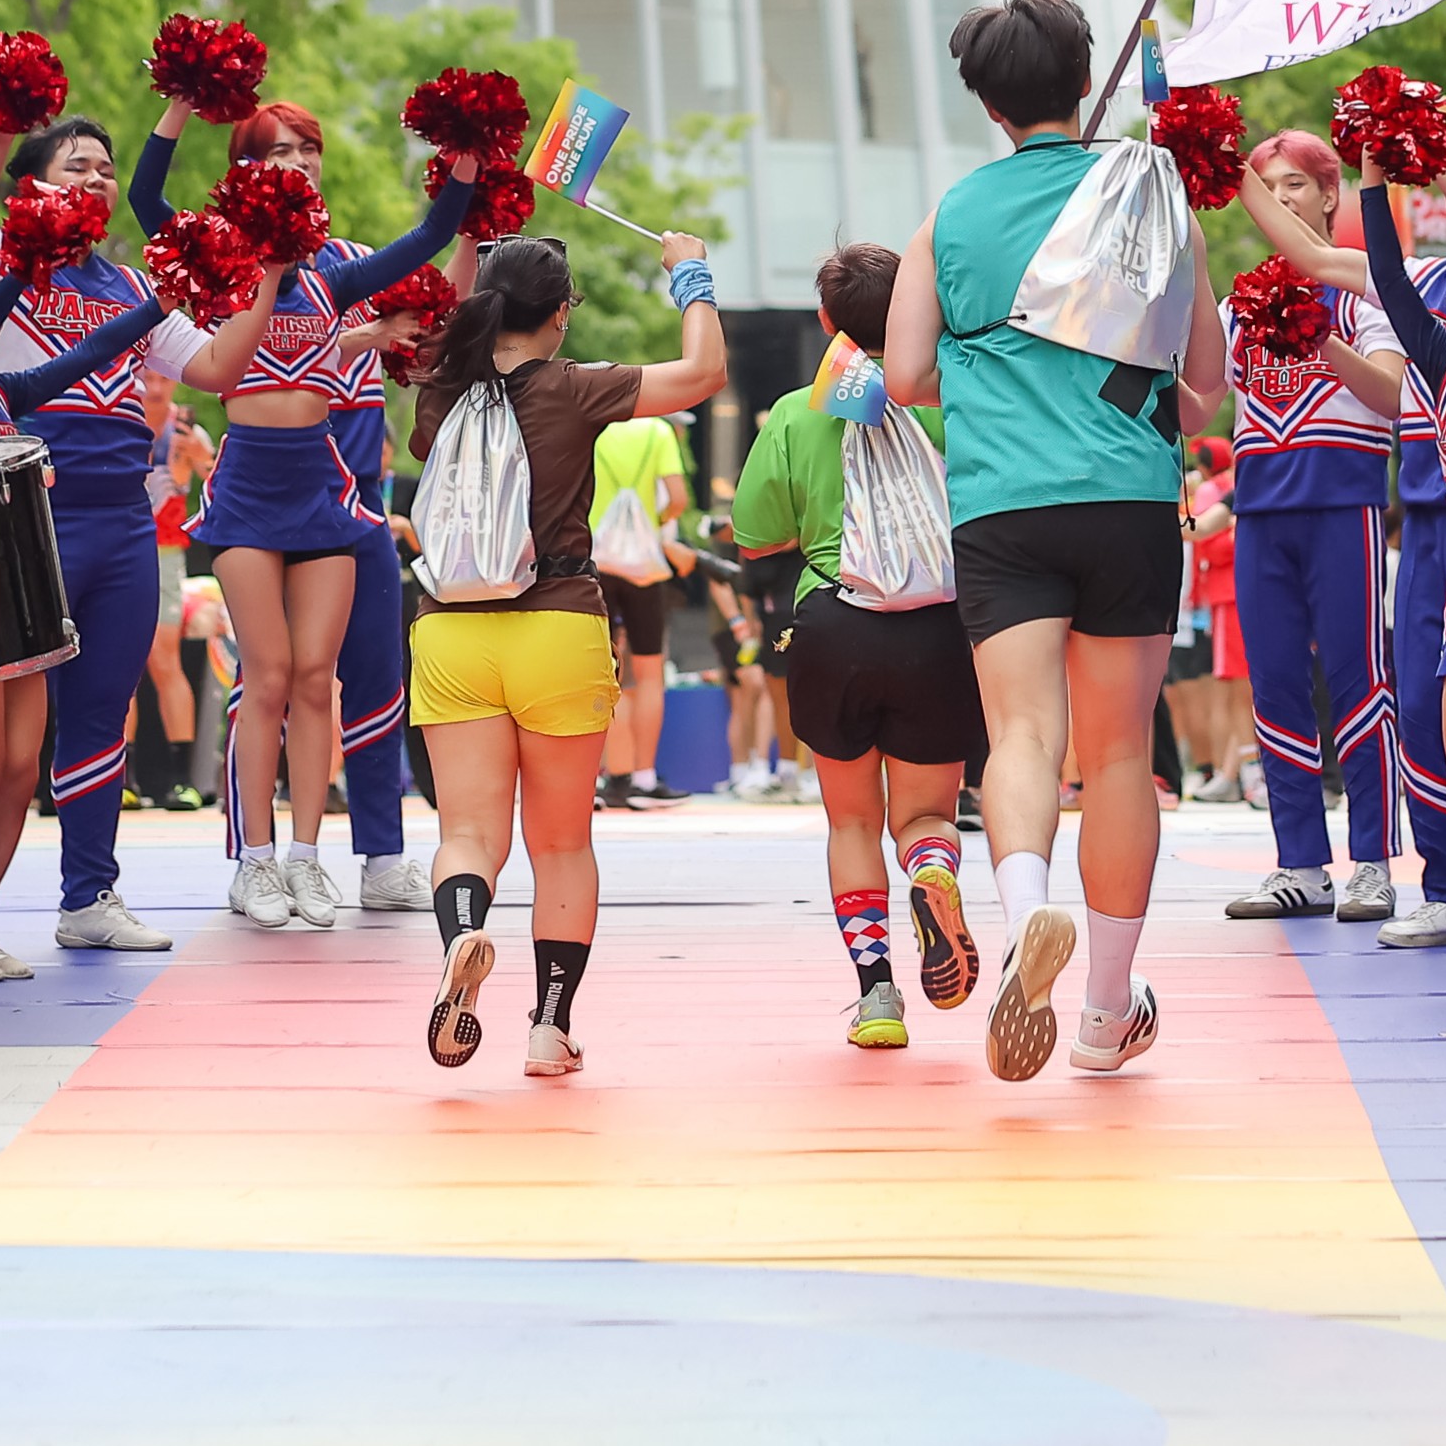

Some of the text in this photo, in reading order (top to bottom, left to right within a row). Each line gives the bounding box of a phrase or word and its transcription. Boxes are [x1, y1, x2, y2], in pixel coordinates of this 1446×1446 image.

[545, 149, 569, 184] ONE
[562, 104, 588, 151] PRIDE
[561, 116, 597, 185] ONE RUN
[836, 367, 858, 401] ONE
[852, 366, 874, 399] ONE
[455, 887, 473, 926] RUNNING
[540, 982, 564, 1026] RUNNING
